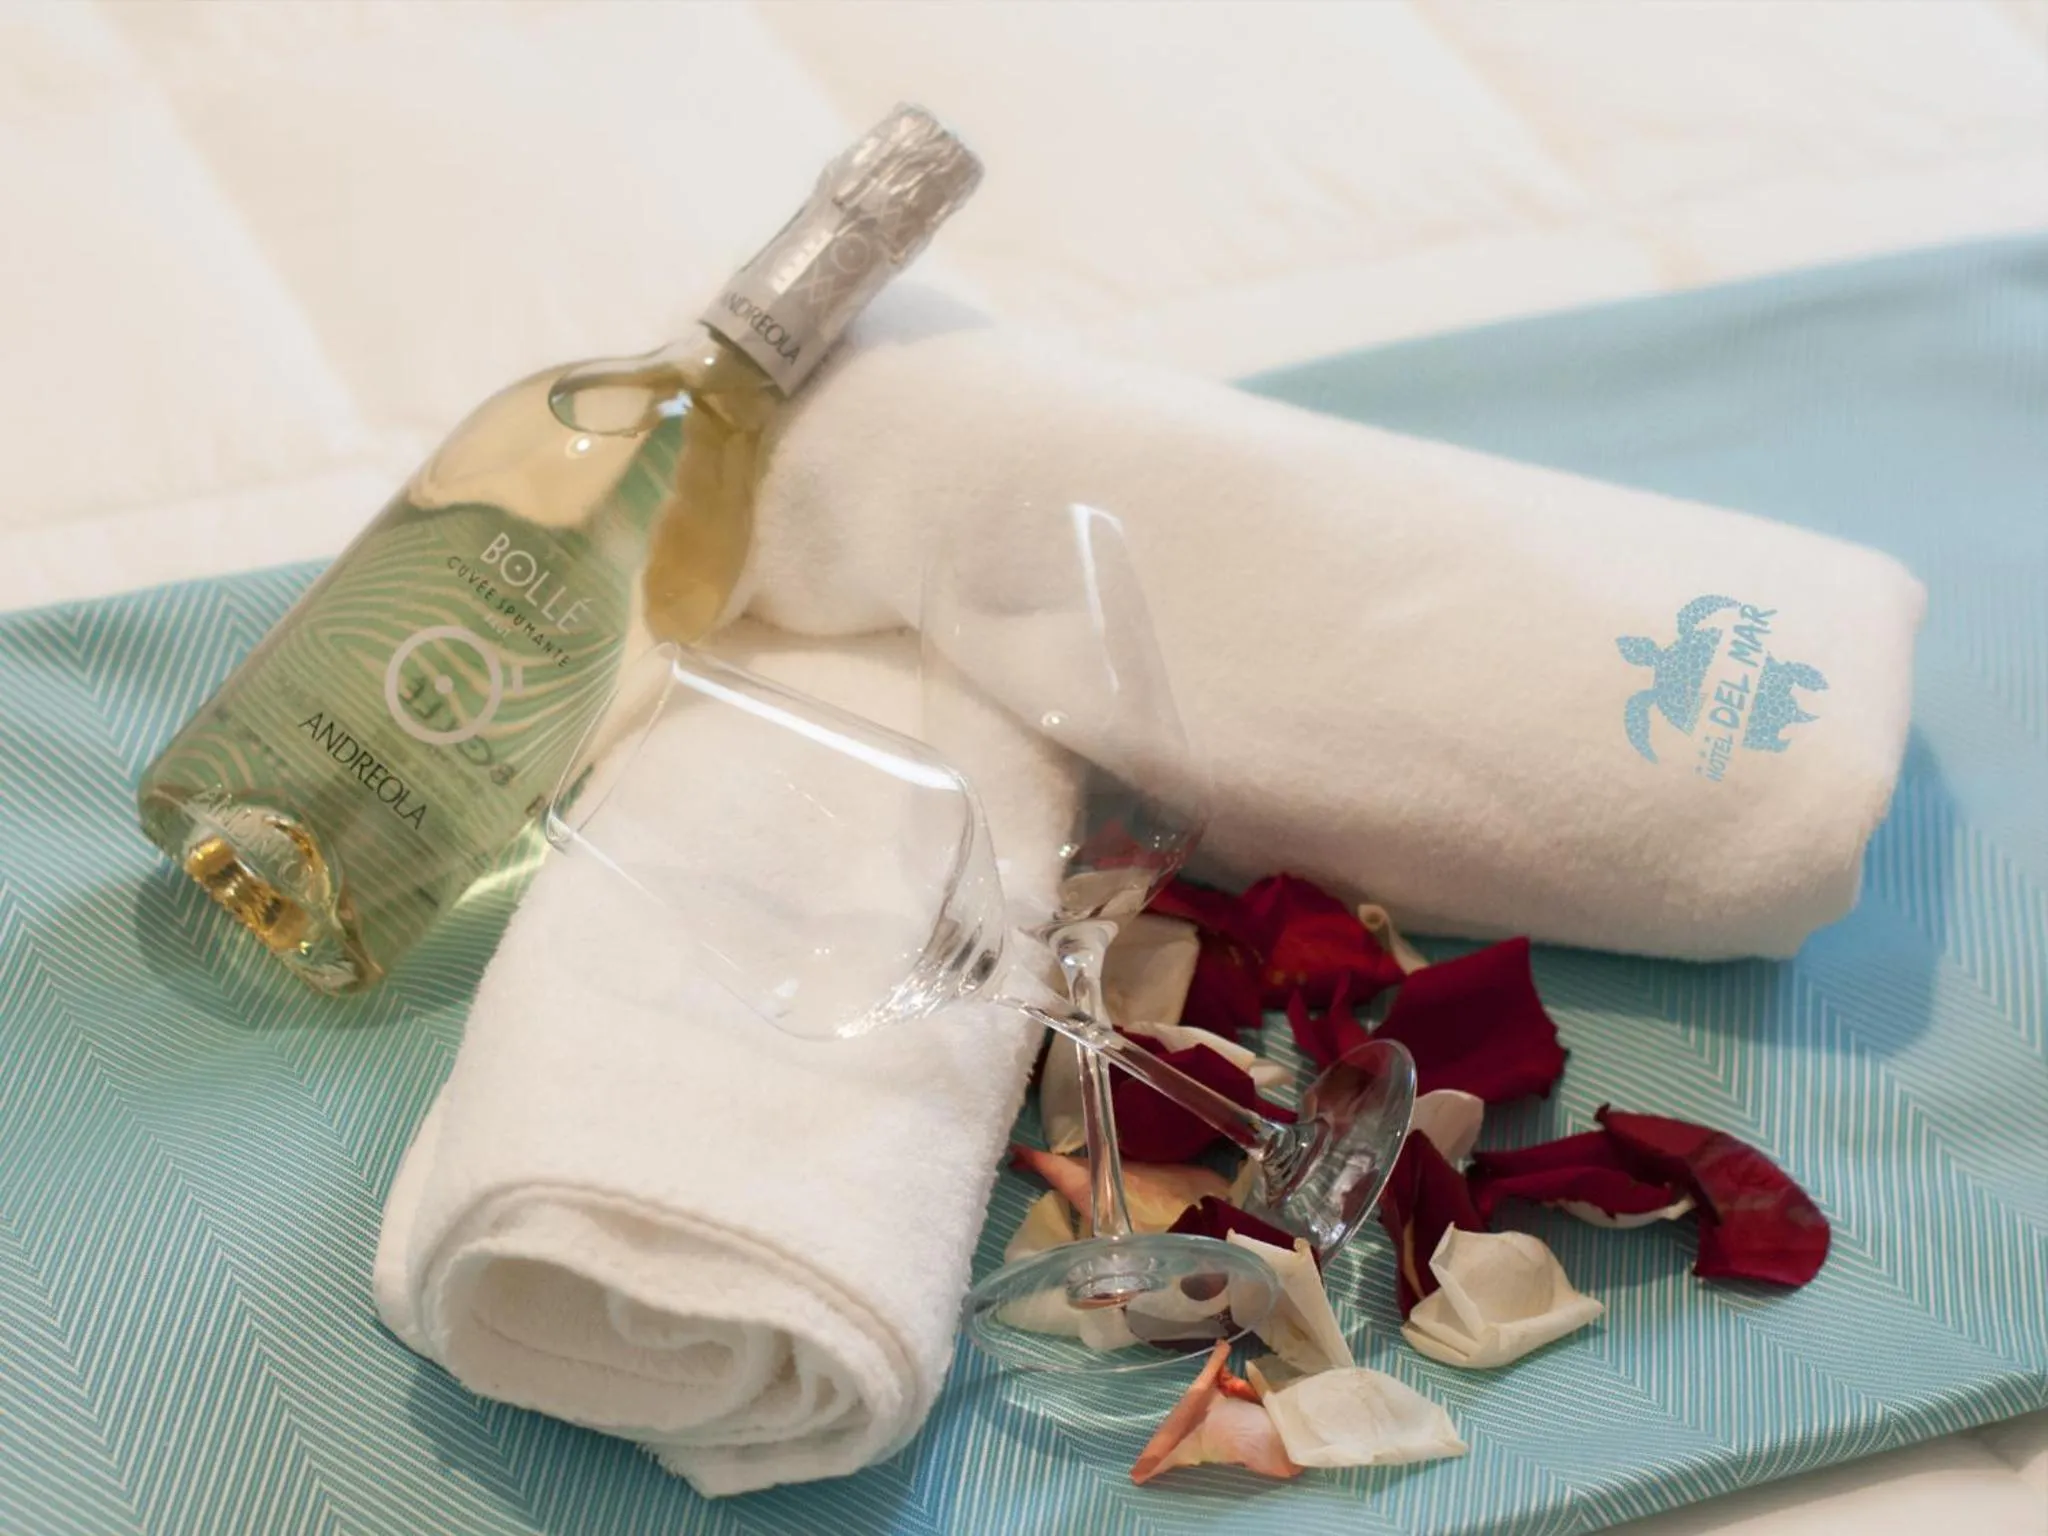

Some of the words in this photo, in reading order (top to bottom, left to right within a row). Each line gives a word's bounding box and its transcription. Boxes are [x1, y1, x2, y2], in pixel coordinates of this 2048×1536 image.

[496, 597, 571, 668] SPUMANTE
[1728, 604, 1778, 668] MAR
[1708, 673, 1751, 729] DEL
[298, 712, 427, 830] ANDREOLA
[1706, 734, 1734, 783] HOTEL
